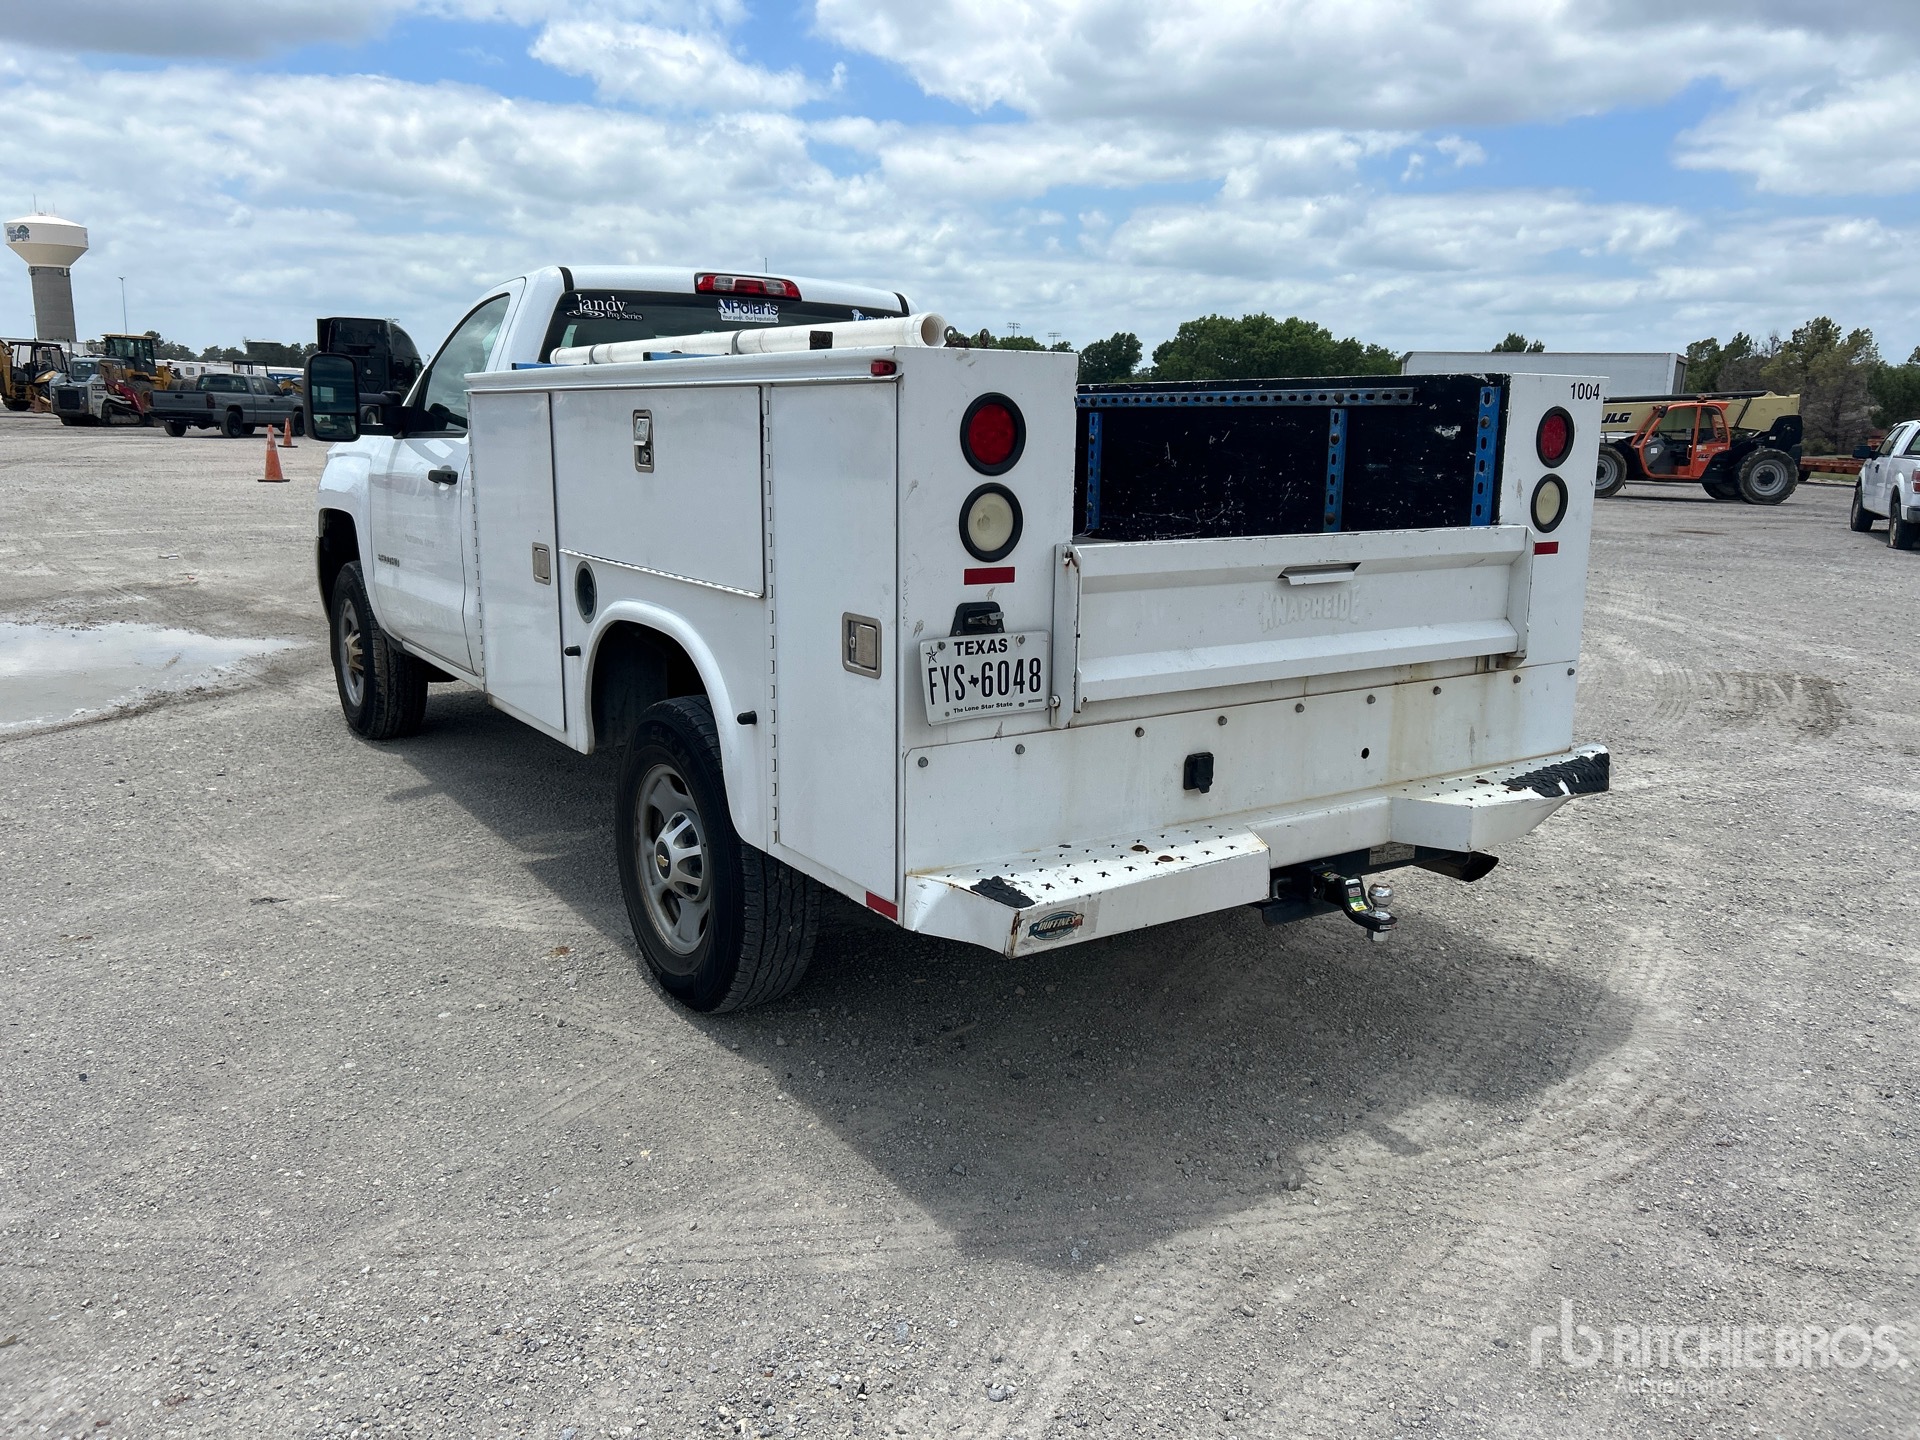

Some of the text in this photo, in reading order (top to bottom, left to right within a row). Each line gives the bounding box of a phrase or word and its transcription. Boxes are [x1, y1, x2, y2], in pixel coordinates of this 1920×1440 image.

[731, 300, 779, 315] Polaris
[621, 312, 643, 320] Series
[1571, 382, 1600, 400] 1004
[1601, 412, 1632, 424] JLG
[954, 638, 1008, 656] TEXAS
[928, 657, 1041, 705] FYS 6048
